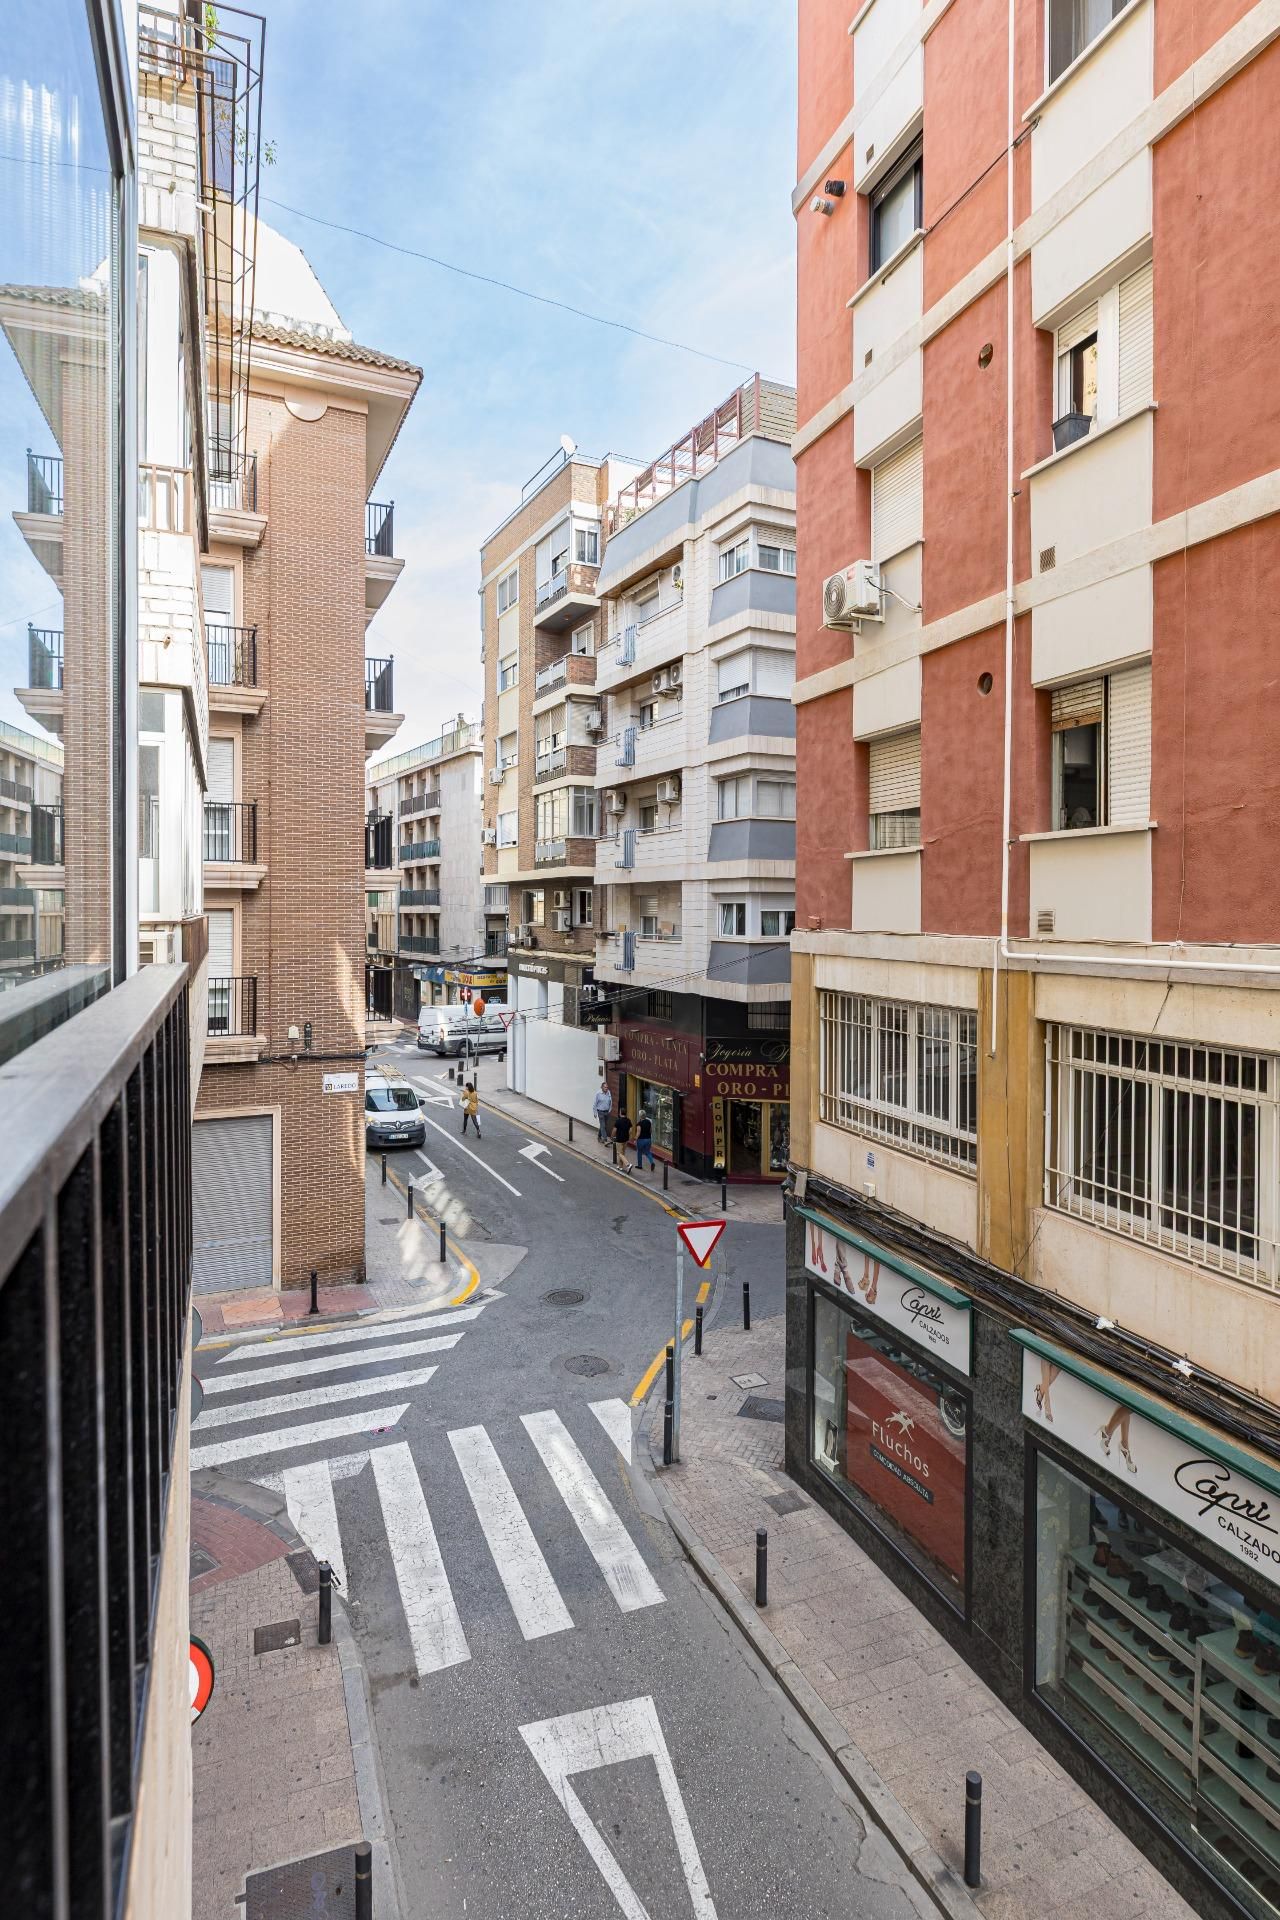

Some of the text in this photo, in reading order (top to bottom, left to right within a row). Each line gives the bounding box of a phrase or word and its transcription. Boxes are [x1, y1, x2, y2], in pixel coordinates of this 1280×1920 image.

[631, 1048, 647, 1061] ORO
[654, 1055, 679, 1072] PLATA
[705, 1063, 778, 1078] COMPRA
[717, 1081, 757, 1096] ORO
[900, 1286, 945, 1325] Capri
[919, 1320, 950, 1345] CALZADOS
[872, 1420, 929, 1478] Fluchos
[872, 1449, 930, 1500] COMODIDAD ABSOLUTA
[1174, 1459, 1279, 1535] Capri
[1239, 1544, 1259, 1563] 1982
